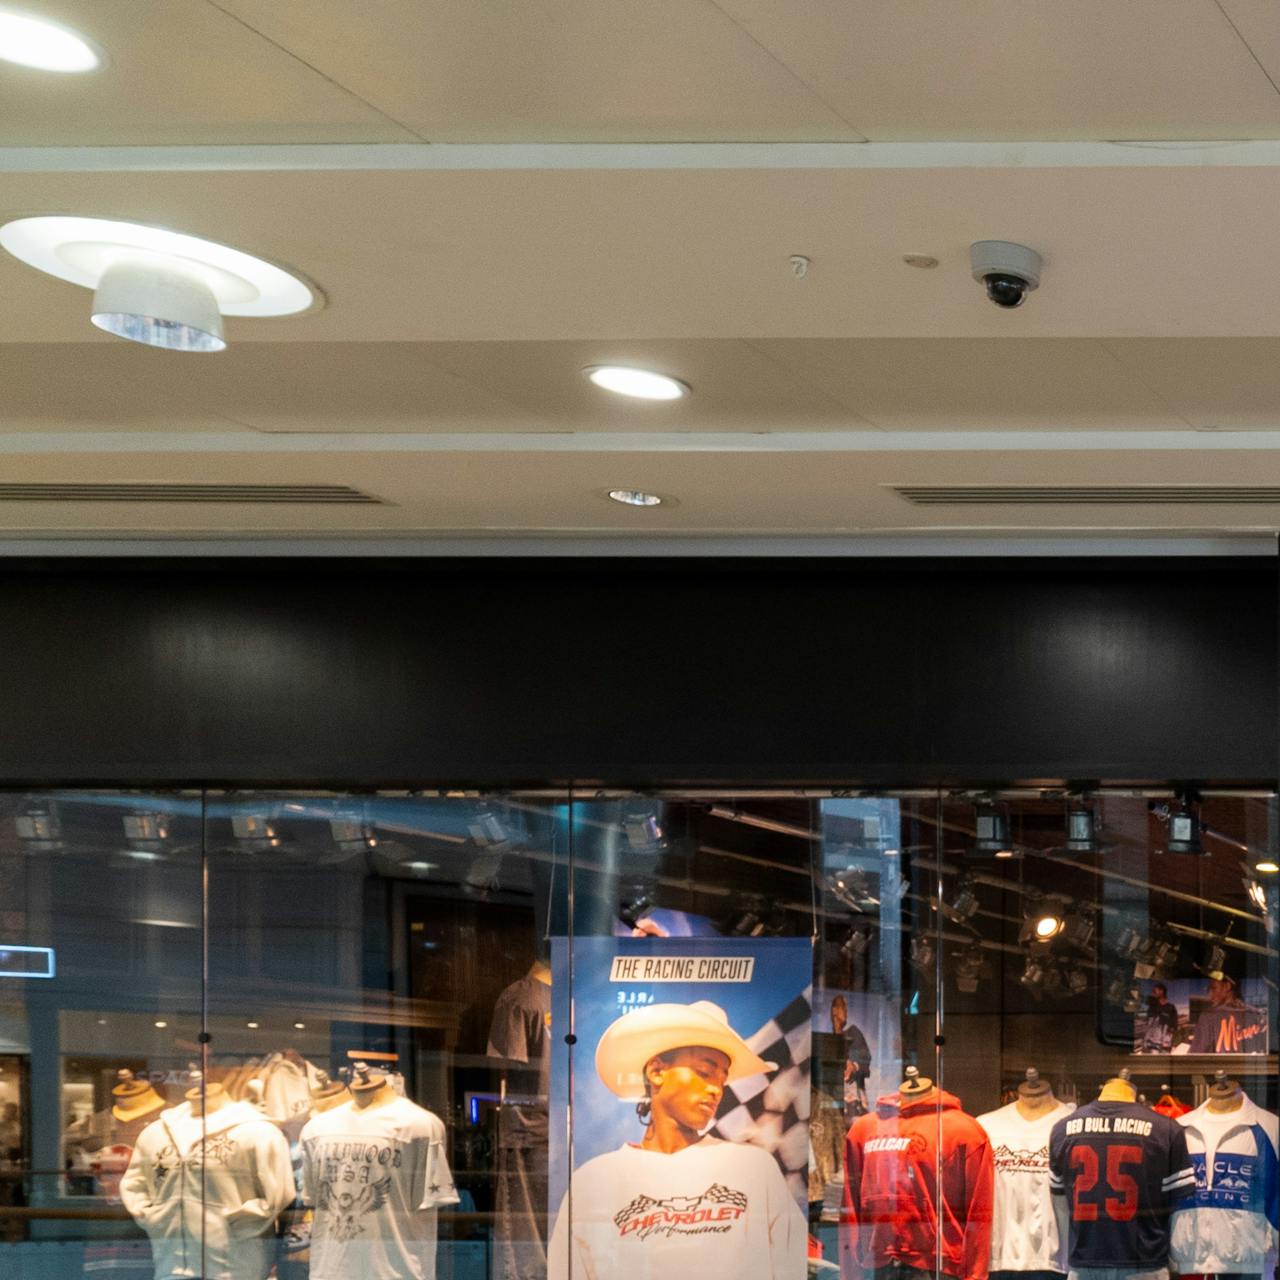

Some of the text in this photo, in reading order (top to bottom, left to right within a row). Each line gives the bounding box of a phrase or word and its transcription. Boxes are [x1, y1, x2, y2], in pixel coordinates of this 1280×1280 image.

[615, 959, 751, 980] THE RACING CIRCUIT
[1066, 1117, 1153, 1137] RED BULL RACING
[864, 1137, 912, 1154] HELLCAT
[1193, 1160, 1253, 1176] ACLE
[1069, 1144, 1144, 1222] 25
[619, 1206, 744, 1237] CHEVROLET
[636, 1223, 733, 1242] Performance
